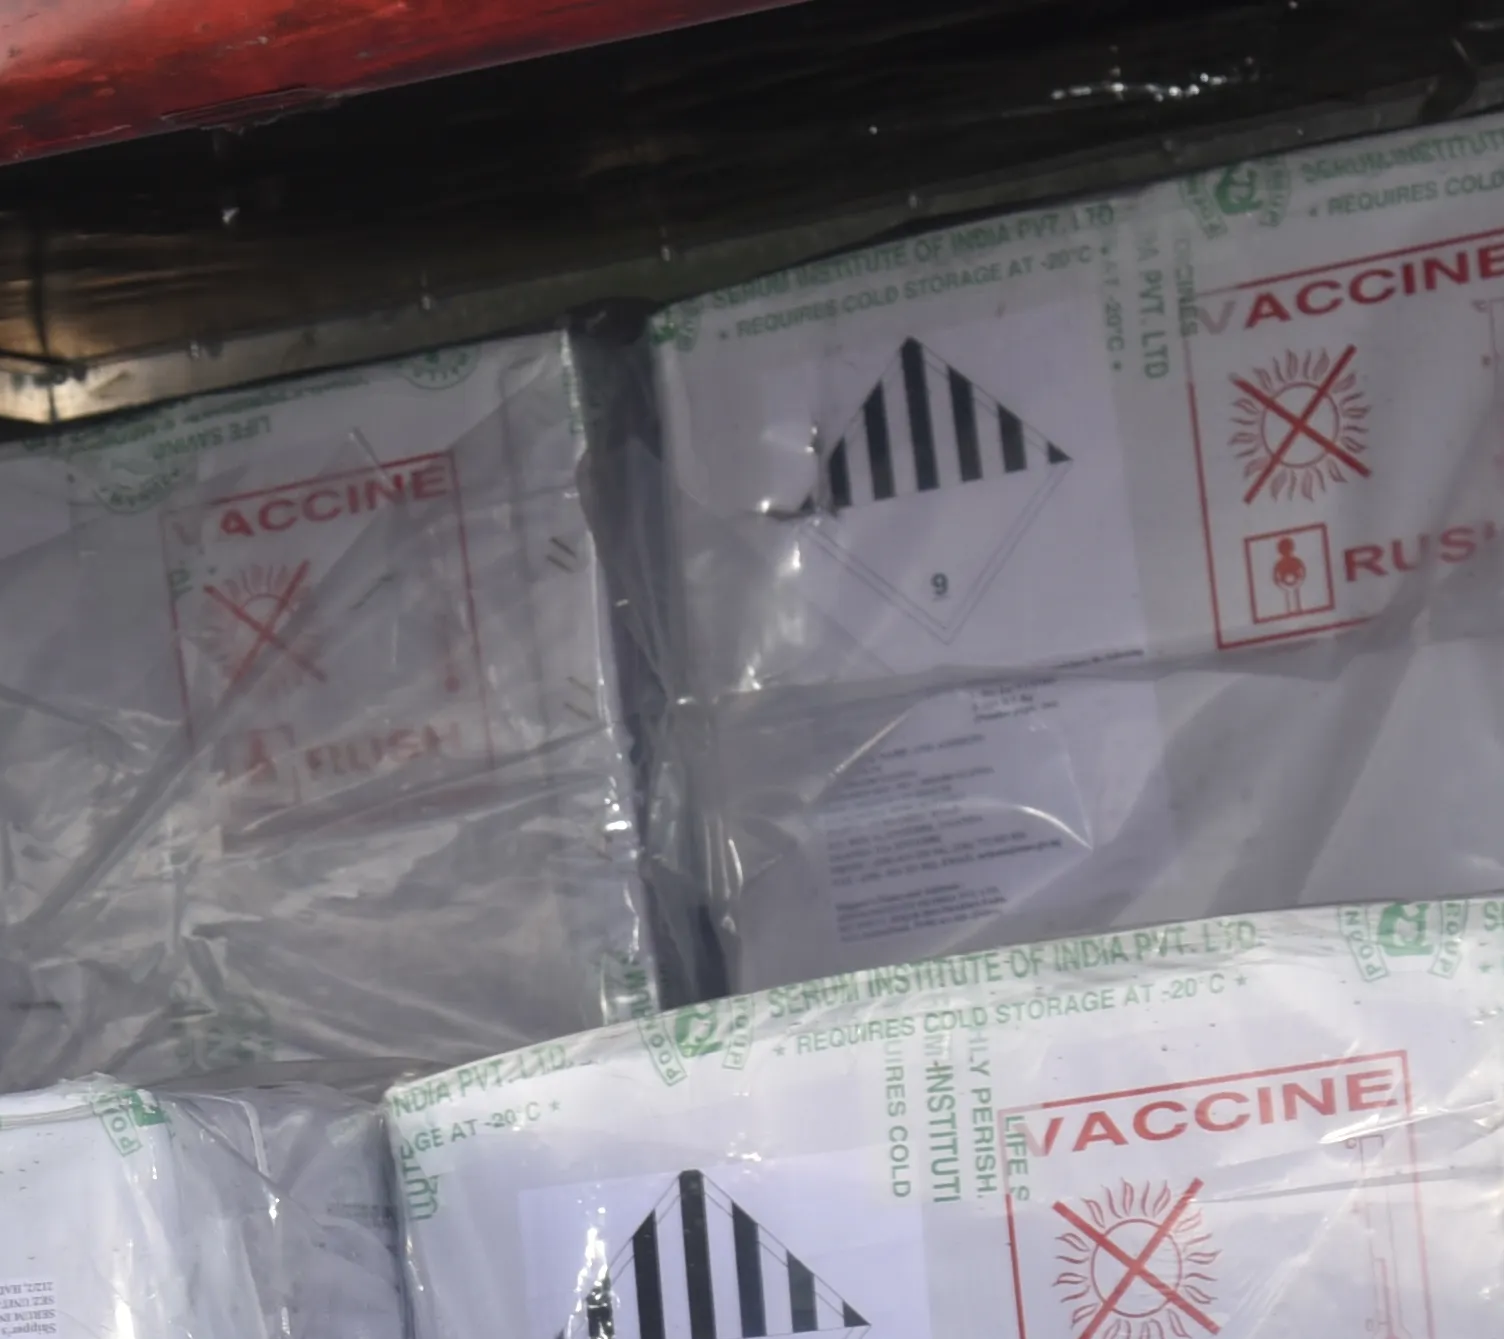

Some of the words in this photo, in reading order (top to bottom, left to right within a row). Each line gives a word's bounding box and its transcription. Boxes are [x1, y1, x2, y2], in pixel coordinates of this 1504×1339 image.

[929, 571, 950, 597] 9
[795, 1018, 916, 1056] REQUIRES
[925, 1007, 988, 1037] COLD
[995, 989, 1115, 1027] STORAGE
[1124, 983, 1155, 1009] AT
[1161, 973, 1225, 1004] -20°C
[1022, 1068, 1399, 1160] VACCINE
